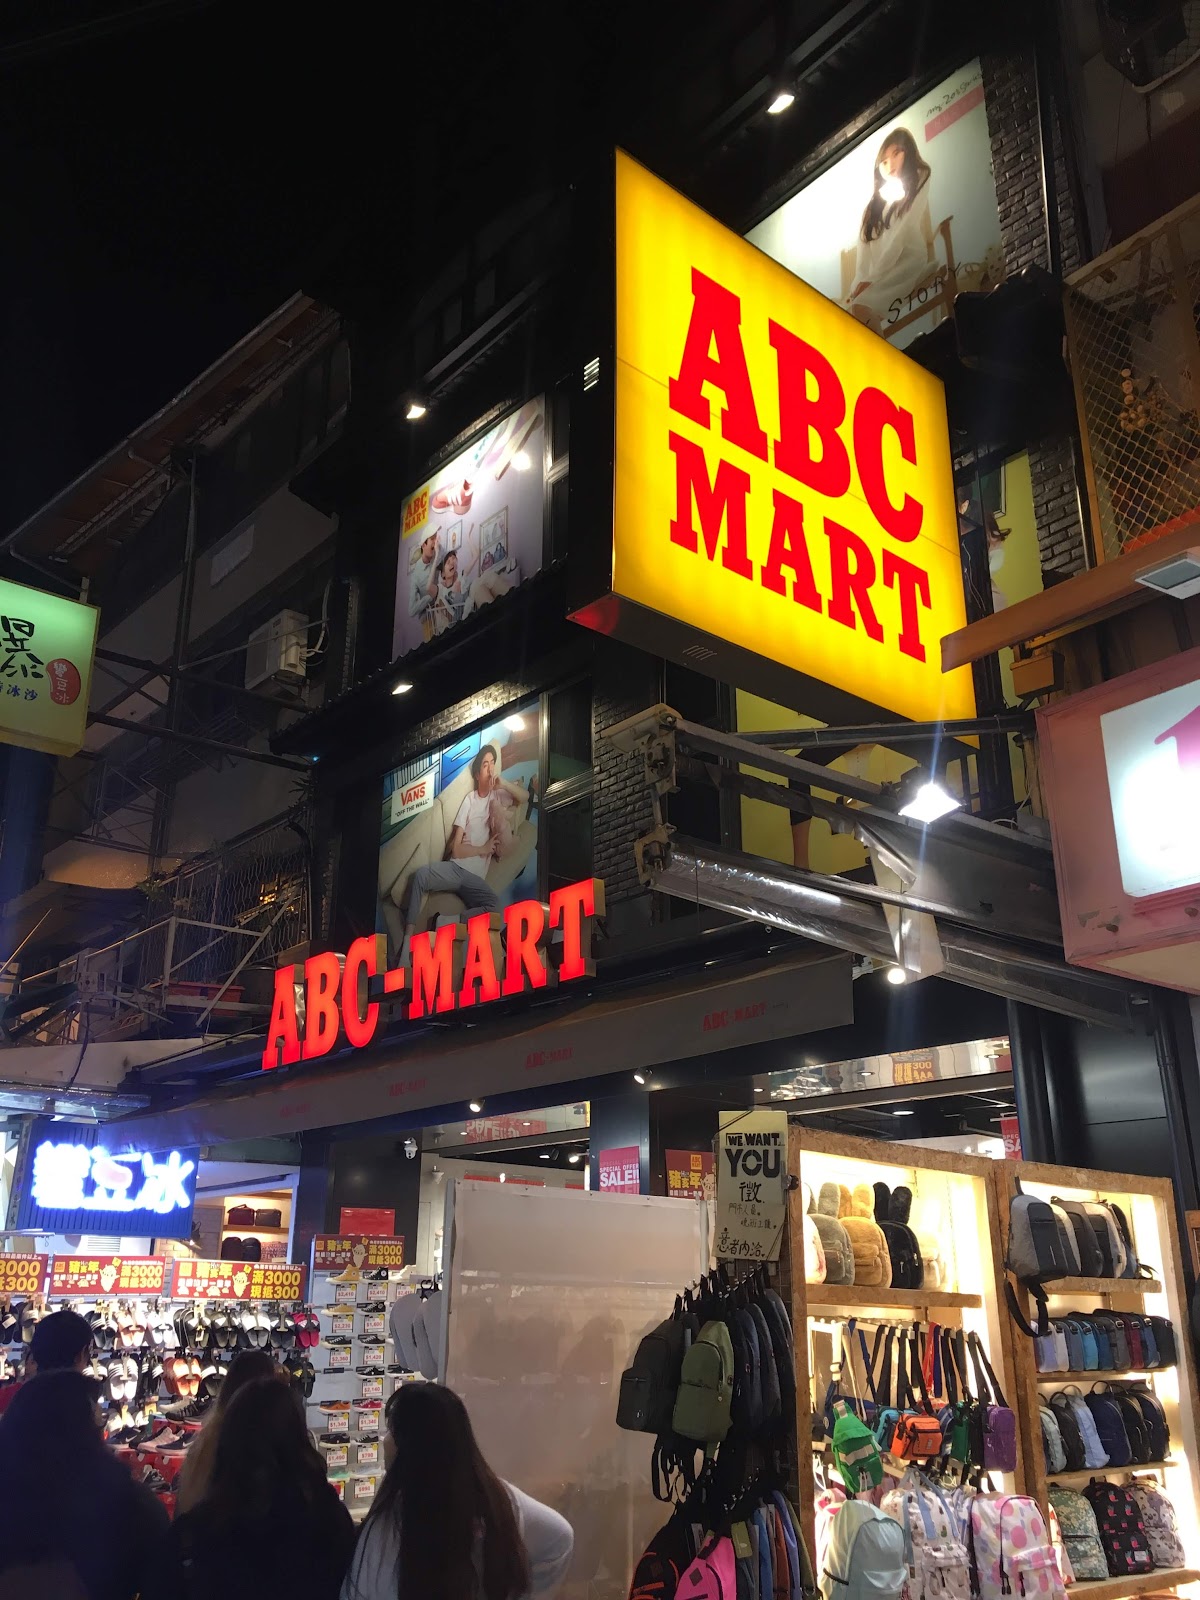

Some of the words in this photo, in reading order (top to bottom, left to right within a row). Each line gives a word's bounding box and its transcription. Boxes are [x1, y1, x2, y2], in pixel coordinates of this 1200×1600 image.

[887, 262, 961, 324] STORY
[669, 267, 923, 542] ABC
[405, 491, 427, 520] ABC
[405, 508, 426, 533] MART
[669, 431, 931, 662] MART
[0, 681, 38, 701] 冰沙
[401, 781, 426, 807] VANS
[406, 804, 414, 813] THE
[263, 879, 594, 1069] ABC-MART
[744, 1133, 779, 1147] WANT
[600, 1165, 621, 1173] SPECIAL
[725, 1149, 780, 1178] YOU
[31, 1141, 194, 1213] 豆冰
[600, 1169, 640, 1188] SALE!!
[368, 1245, 402, 1255] 滿3000
[121, 1265, 163, 1277] 滿3000
[252, 1270, 301, 1286] 滿3000
[250, 1285, 299, 1299] 現抵300
